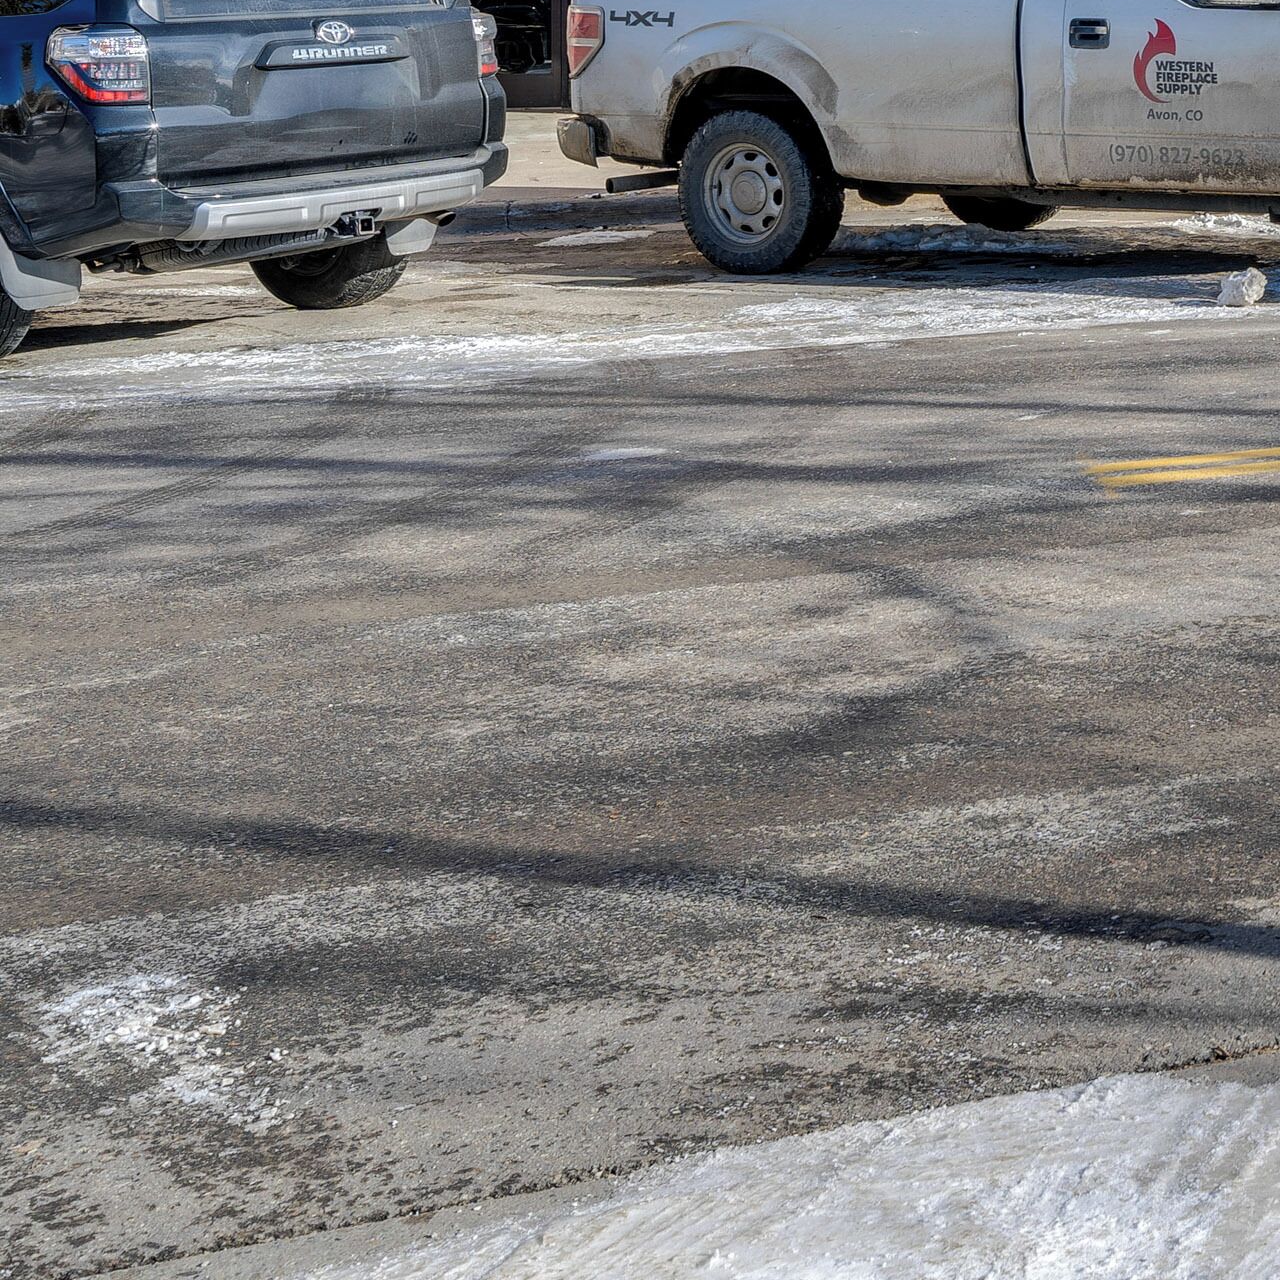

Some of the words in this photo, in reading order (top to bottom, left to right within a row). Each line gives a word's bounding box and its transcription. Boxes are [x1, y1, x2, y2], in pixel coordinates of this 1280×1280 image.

[1155, 60, 1214, 73] WESTERN
[1155, 71, 1218, 84] FIREPLACE
[1156, 83, 1203, 95] SUPPLY
[1147, 108, 1182, 122] Avon,
[1185, 109, 1204, 121] CO
[1109, 143, 1154, 166] (970)
